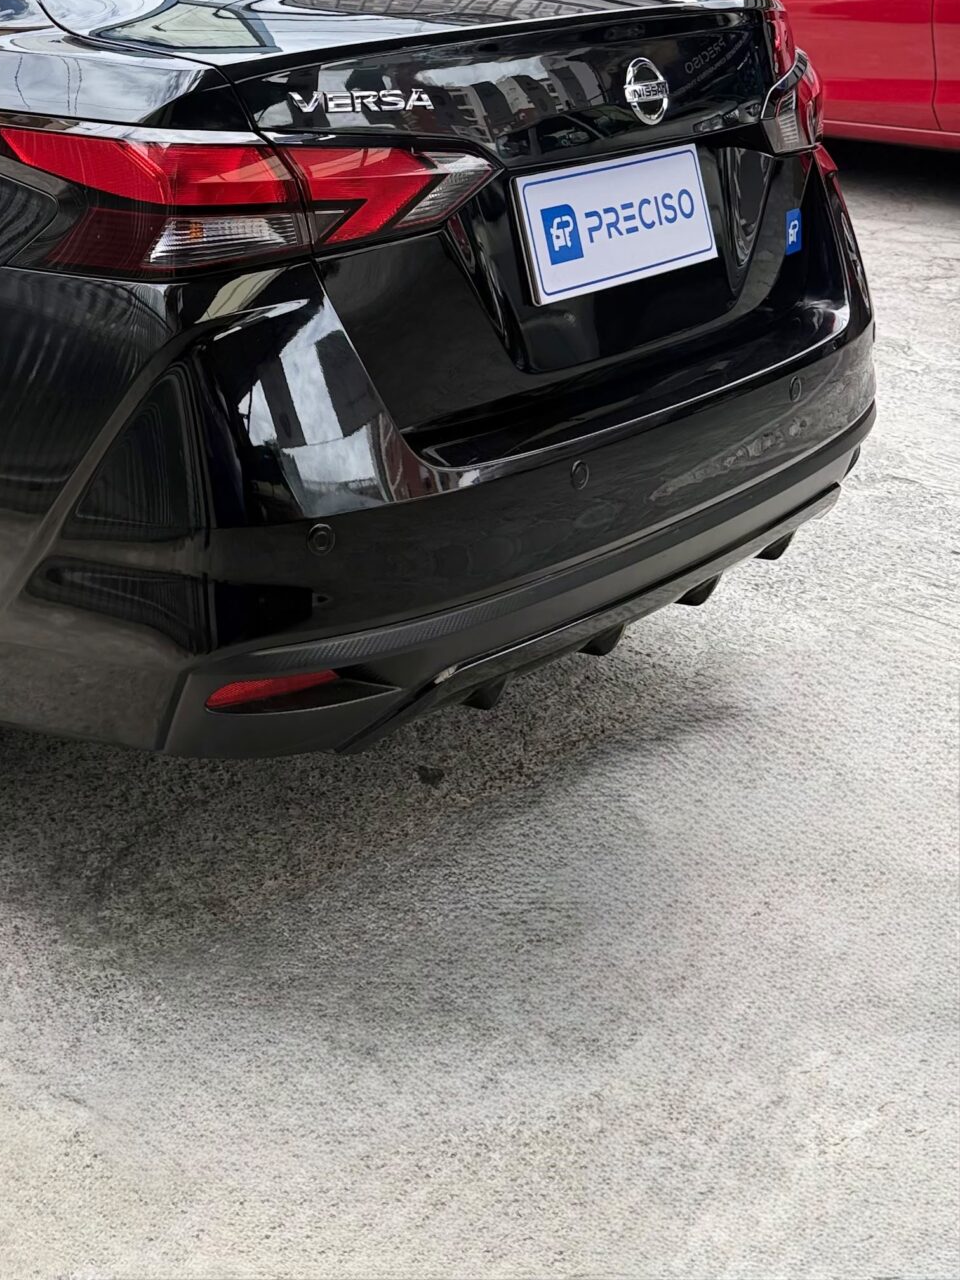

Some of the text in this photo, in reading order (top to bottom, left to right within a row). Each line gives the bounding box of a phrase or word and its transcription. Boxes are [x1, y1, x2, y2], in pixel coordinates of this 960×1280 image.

[288, 88, 435, 113] VERSA
[631, 82, 668, 98] NISSAN
[584, 188, 695, 244] PRECISO
